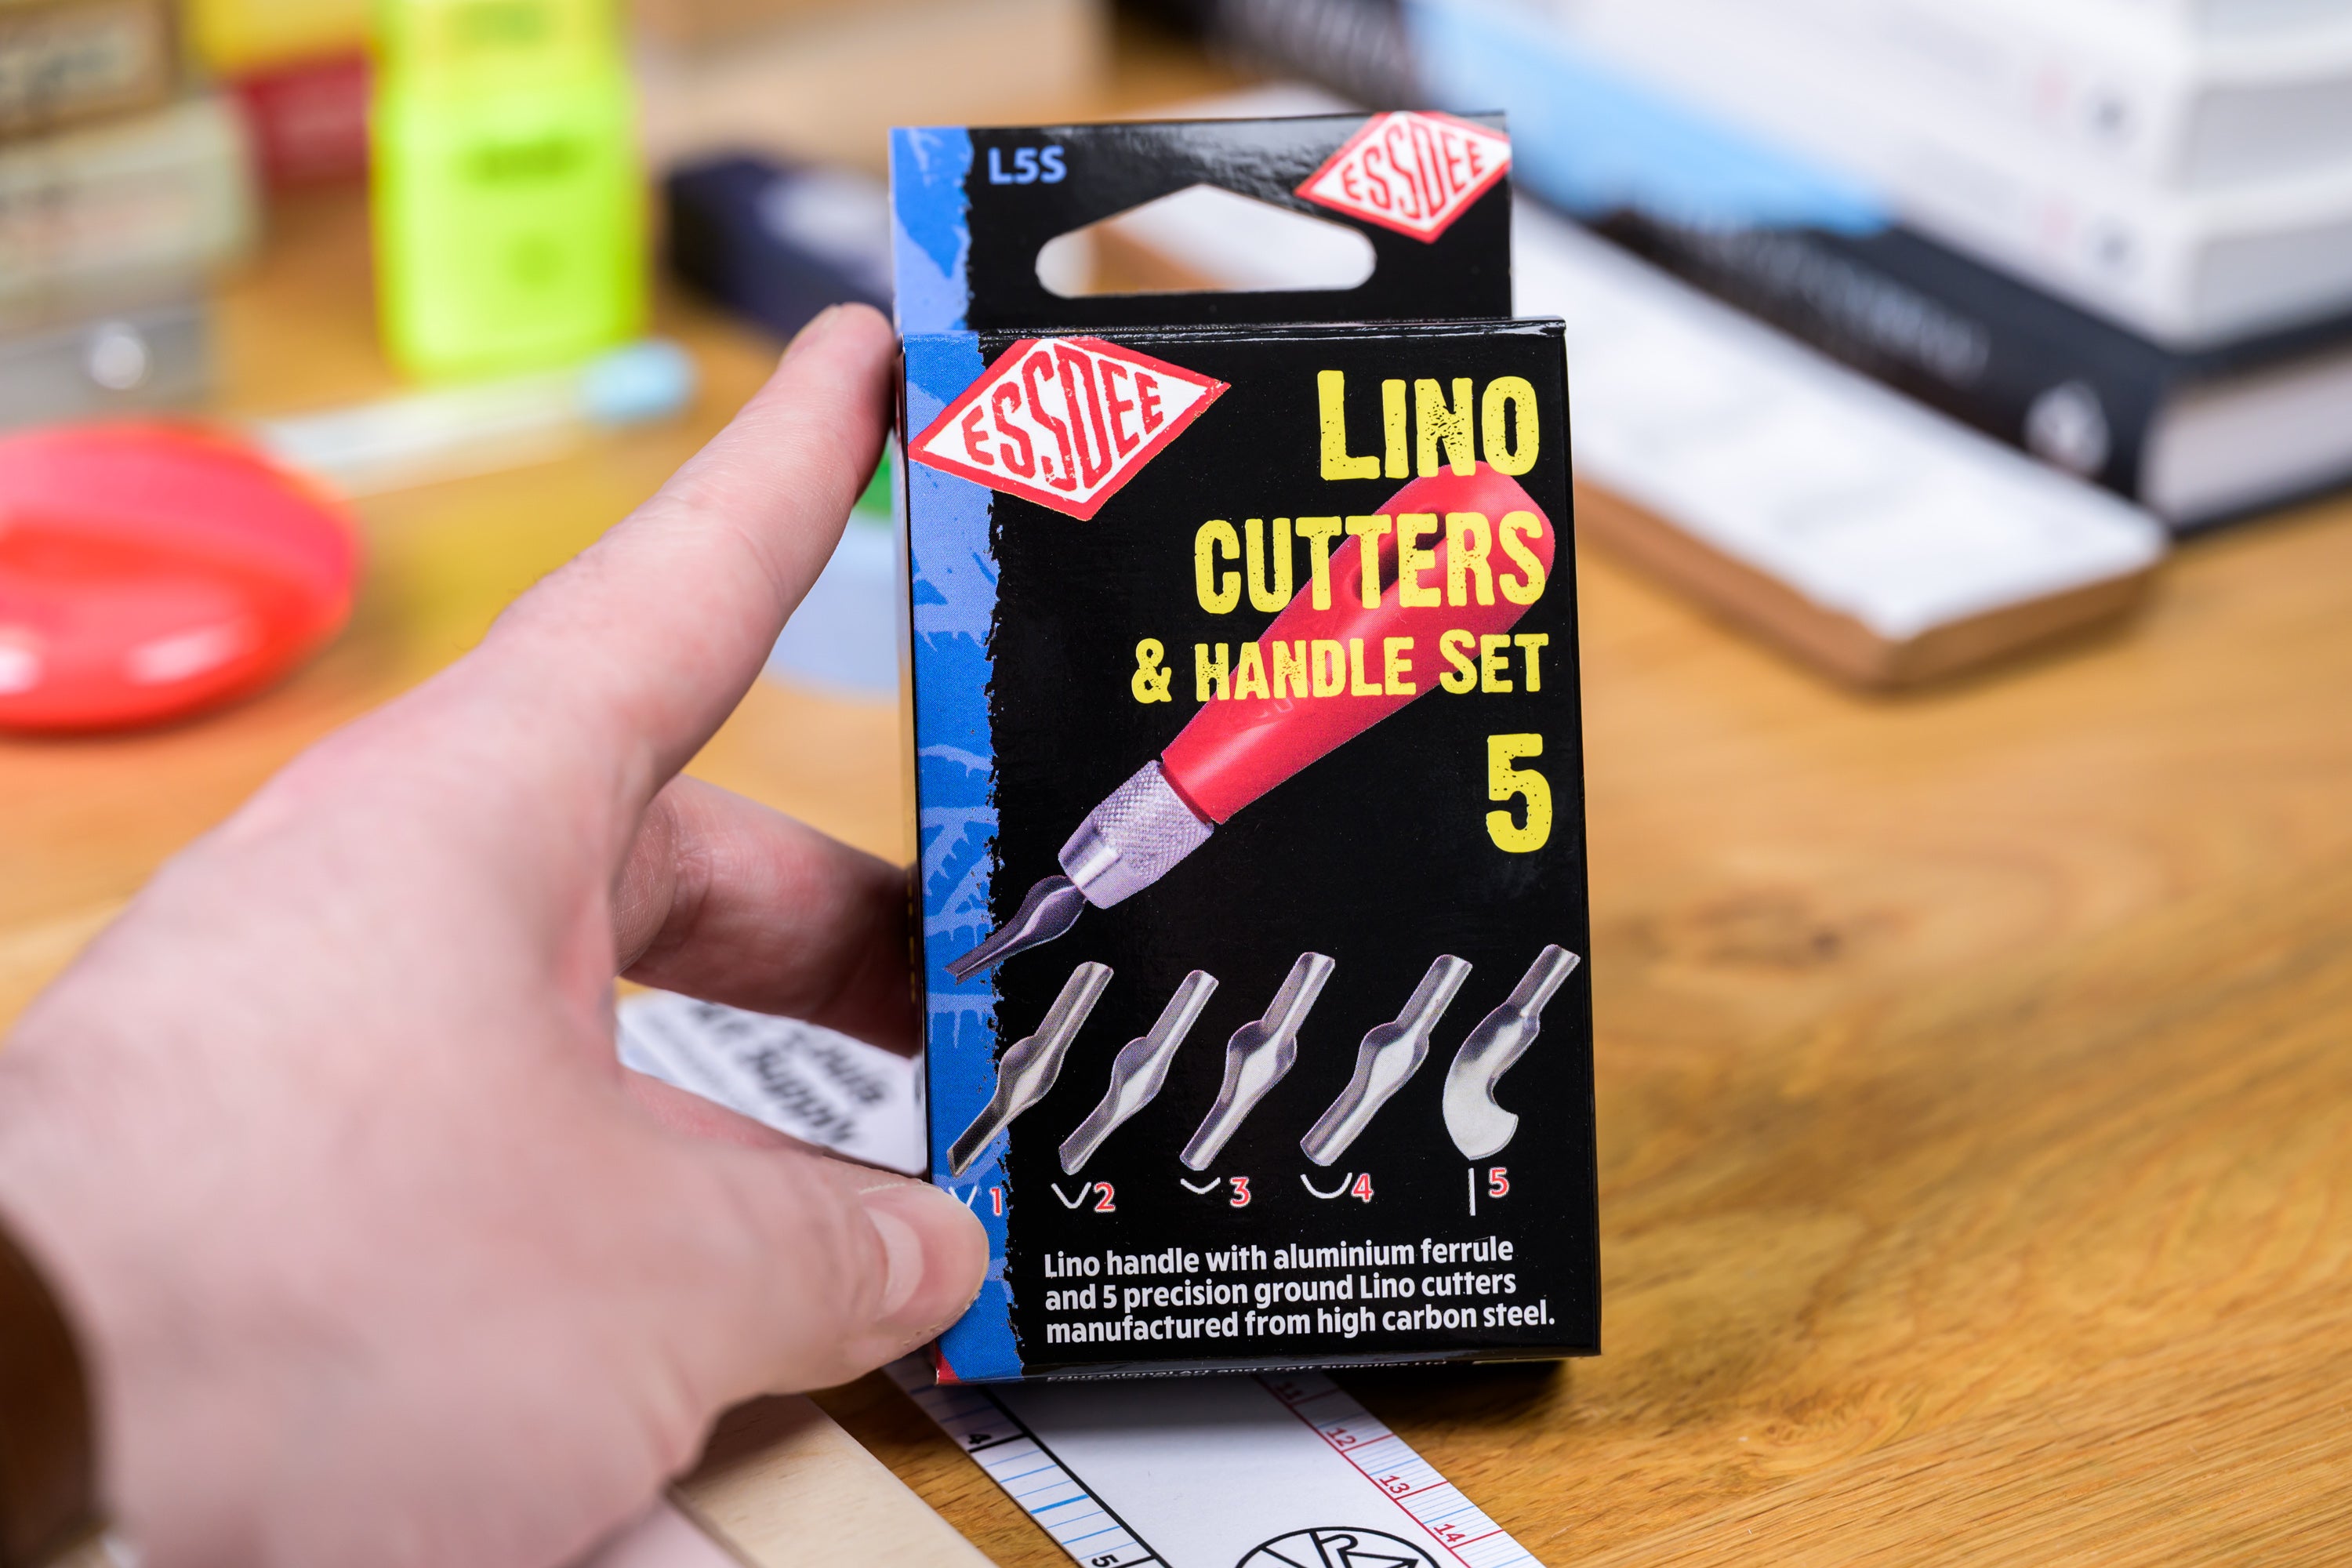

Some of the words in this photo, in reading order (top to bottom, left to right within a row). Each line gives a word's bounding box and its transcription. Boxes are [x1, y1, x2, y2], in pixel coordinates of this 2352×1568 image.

[989, 147, 1067, 185] L5S
[1341, 119, 1485, 218] ESSDEE
[960, 346, 1163, 492] ESSDEE
[1317, 370, 1539, 480] LINO
[1194, 511, 1546, 615] CUTTERS
[1131, 637, 1173, 704] &
[1195, 636, 1417, 702] HANDLE
[1439, 629, 1549, 695] SET
[1486, 733, 1553, 854] 5
[1093, 1181, 1116, 1212] 2
[1229, 1177, 1252, 1207] 3
[1351, 1173, 1374, 1203] 4
[1489, 1167, 1510, 1198] 5
[989, 1187, 1002, 1216] 1
[1044, 1250, 1100, 1278] Lino
[1106, 1247, 1200, 1276] handle
[1205, 1244, 1267, 1272] with
[1273, 1239, 1414, 1270] aluminium
[1421, 1236, 1514, 1264] ferrule
[1045, 1283, 1096, 1311] and
[1103, 1284, 1117, 1309] 5
[1123, 1278, 1248, 1313] precision
[1254, 1274, 1353, 1309] ground
[1359, 1272, 1415, 1299] Lino
[1421, 1271, 1516, 1297] cutters
[1047, 1311, 1239, 1344] manufactured
[1245, 1310, 1311, 1336] from
[1317, 1306, 1376, 1339] high
[1382, 1304, 1477, 1331] carbon
[1483, 1299, 1555, 1327] steel.
[967, 1432, 993, 1445] 4
[1326, 1427, 1357, 1447] 12
[1378, 1475, 1410, 1494] 13
[1433, 1523, 1466, 1542] 14
[1091, 1554, 1120, 1568] 5
